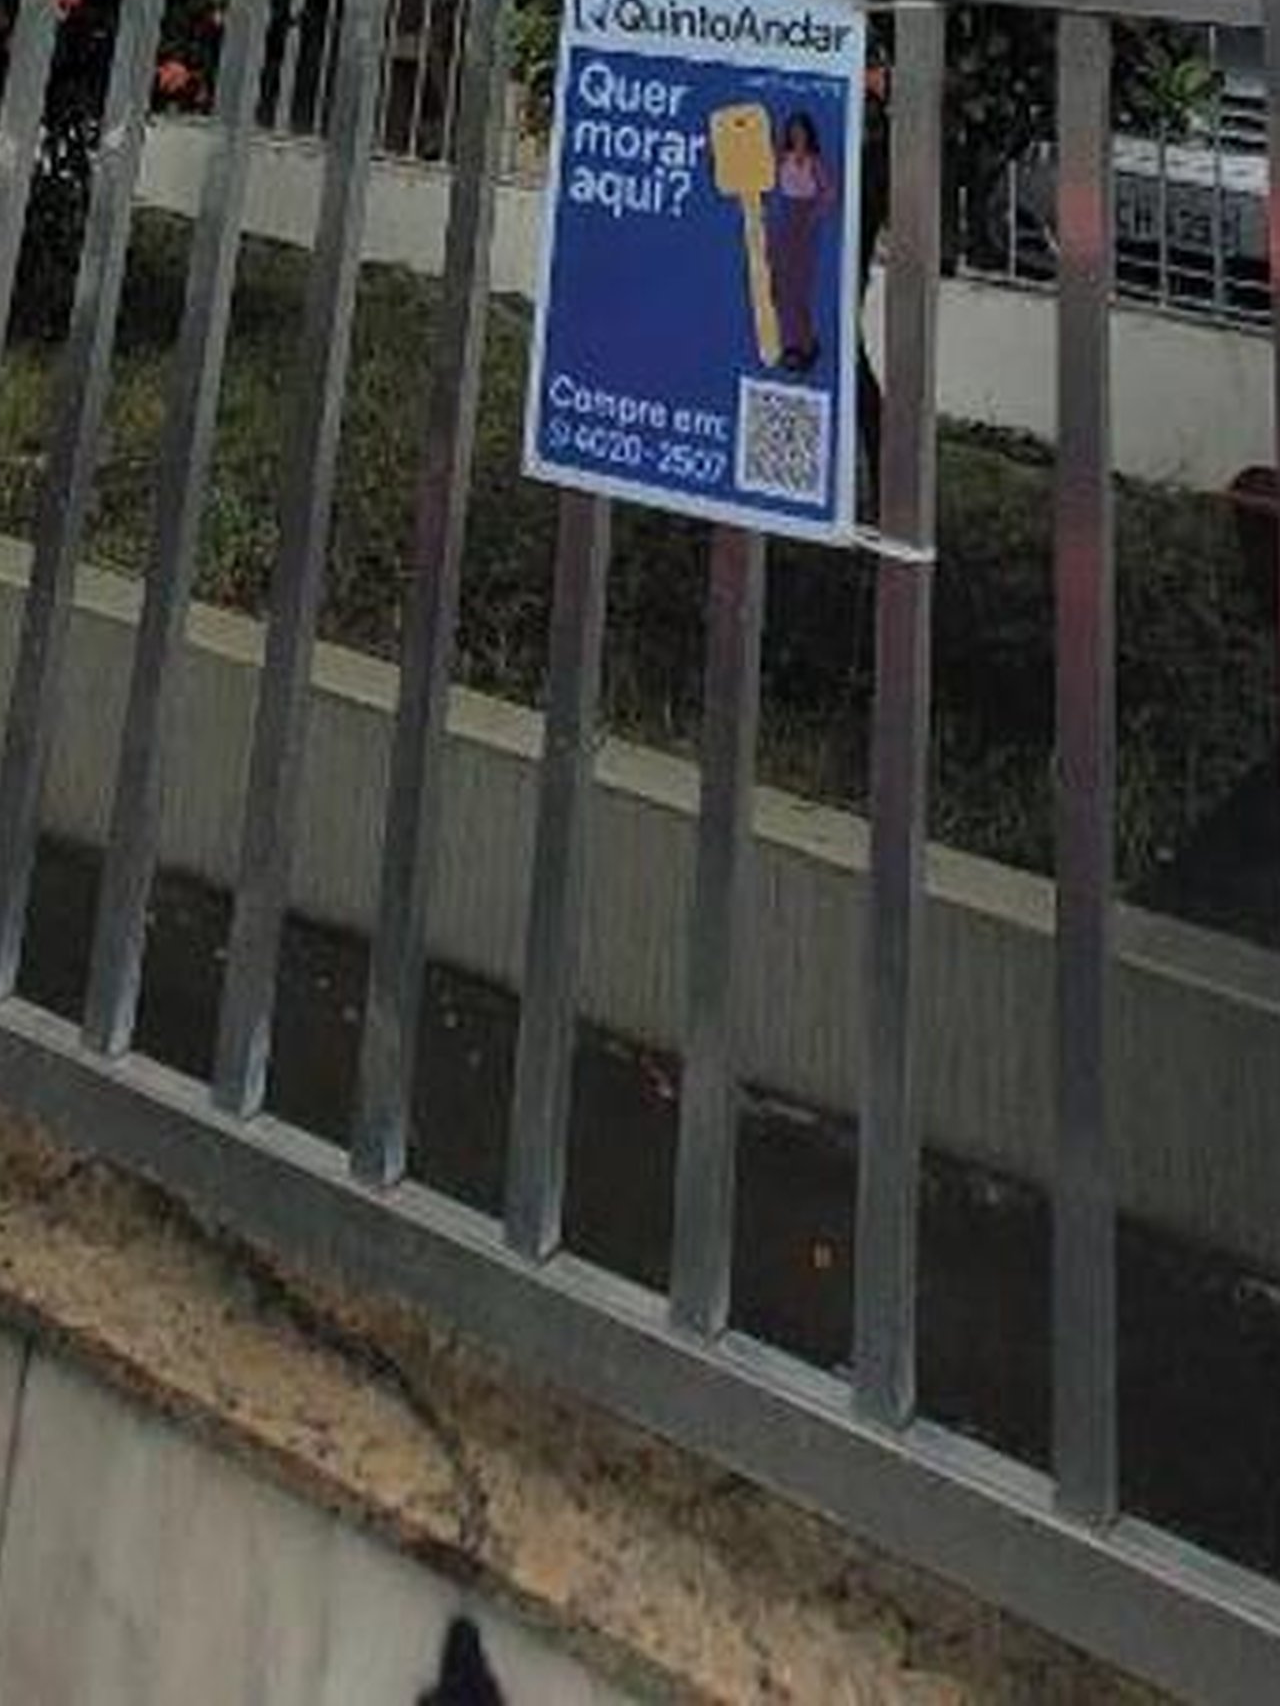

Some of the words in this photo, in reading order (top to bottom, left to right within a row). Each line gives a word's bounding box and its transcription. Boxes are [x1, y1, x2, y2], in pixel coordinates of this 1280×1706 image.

[578, 61, 690, 117] Quer
[573, 118, 706, 168] morar
[569, 165, 692, 218] aqui?
[549, 373, 668, 429] Compre
